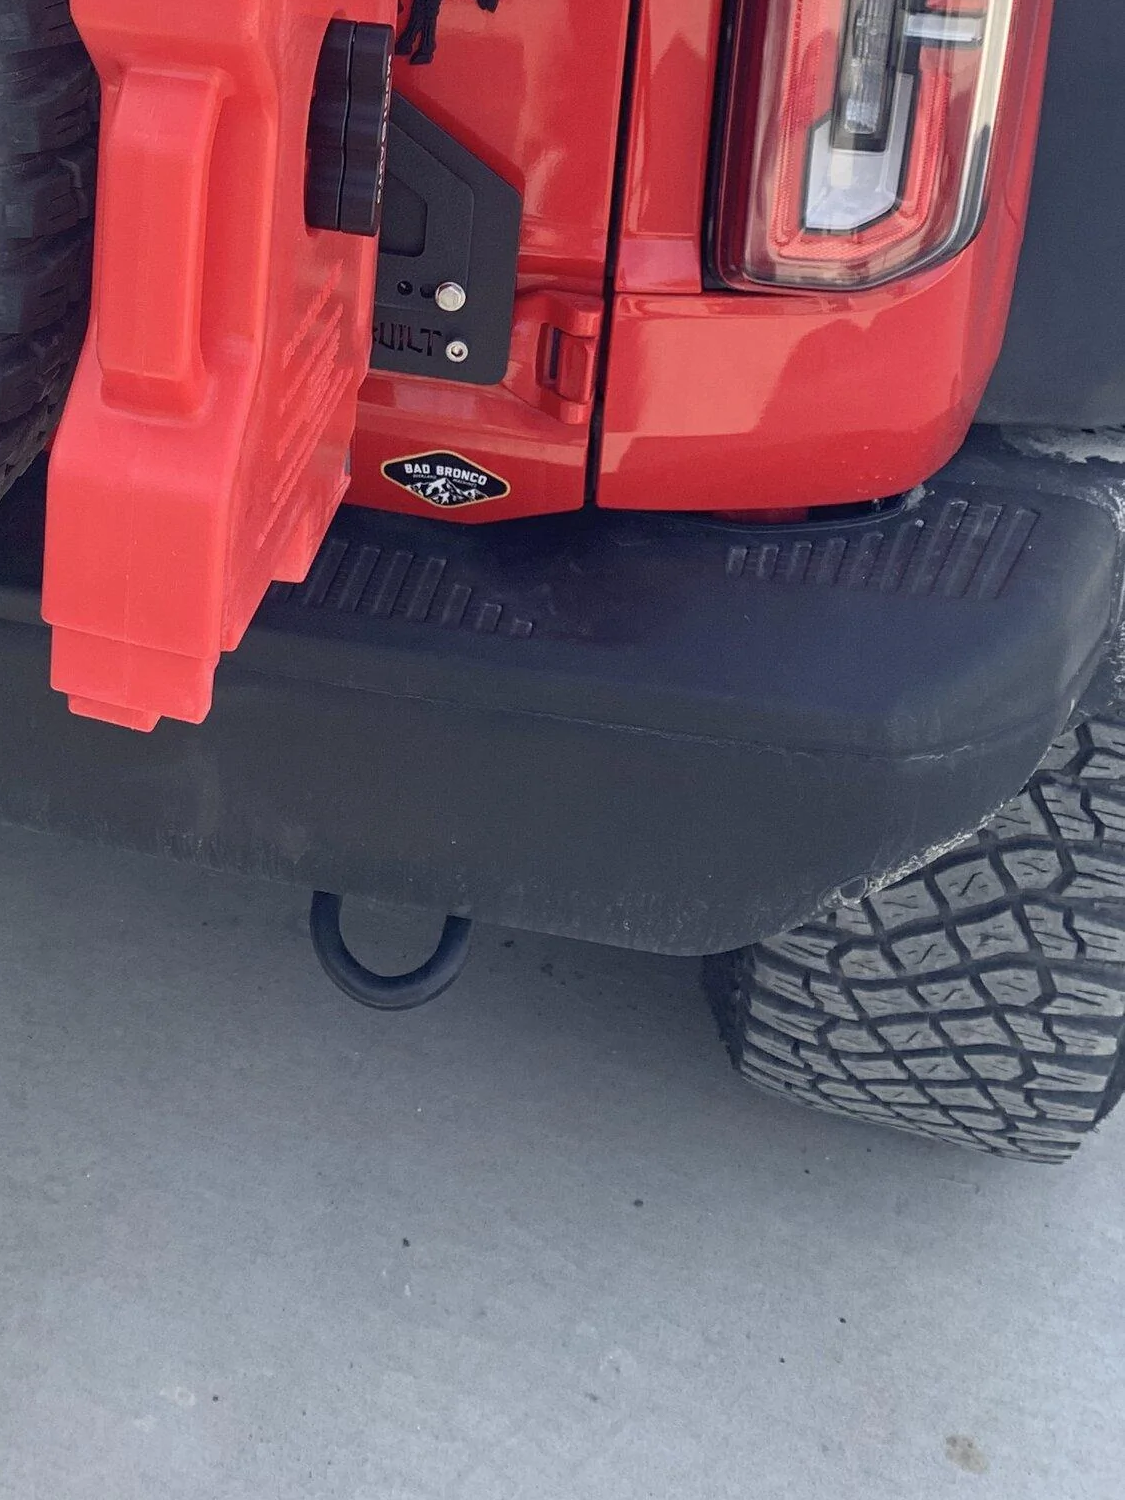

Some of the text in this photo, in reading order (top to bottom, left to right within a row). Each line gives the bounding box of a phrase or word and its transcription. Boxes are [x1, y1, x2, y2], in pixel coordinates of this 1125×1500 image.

[374, 322, 443, 357] UILT
[404, 463, 488, 486] BAD BRONCO
